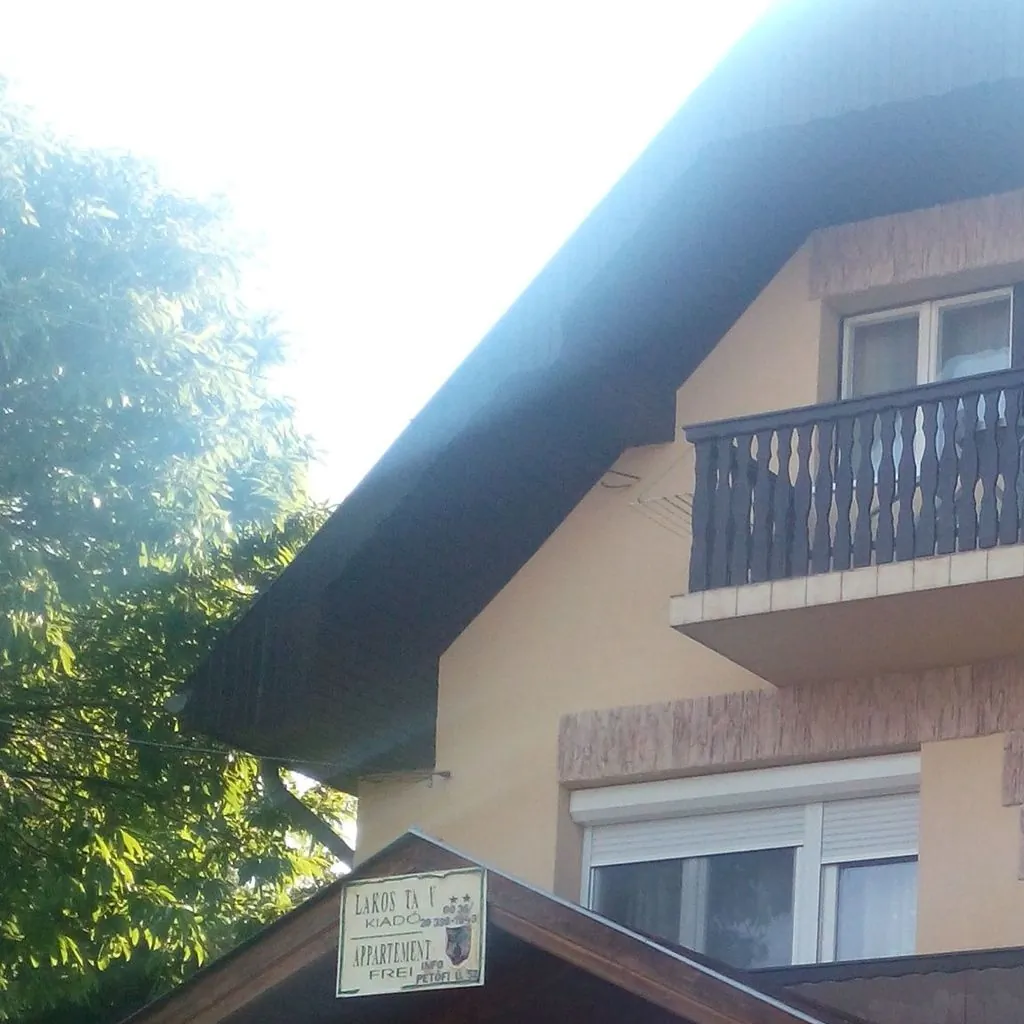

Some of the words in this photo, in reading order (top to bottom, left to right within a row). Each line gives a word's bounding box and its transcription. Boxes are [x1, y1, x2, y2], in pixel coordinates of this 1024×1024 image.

[352, 939, 432, 967] APPARTEMENT
[421, 960, 444, 970] INFO
[369, 967, 413, 980] FREI
